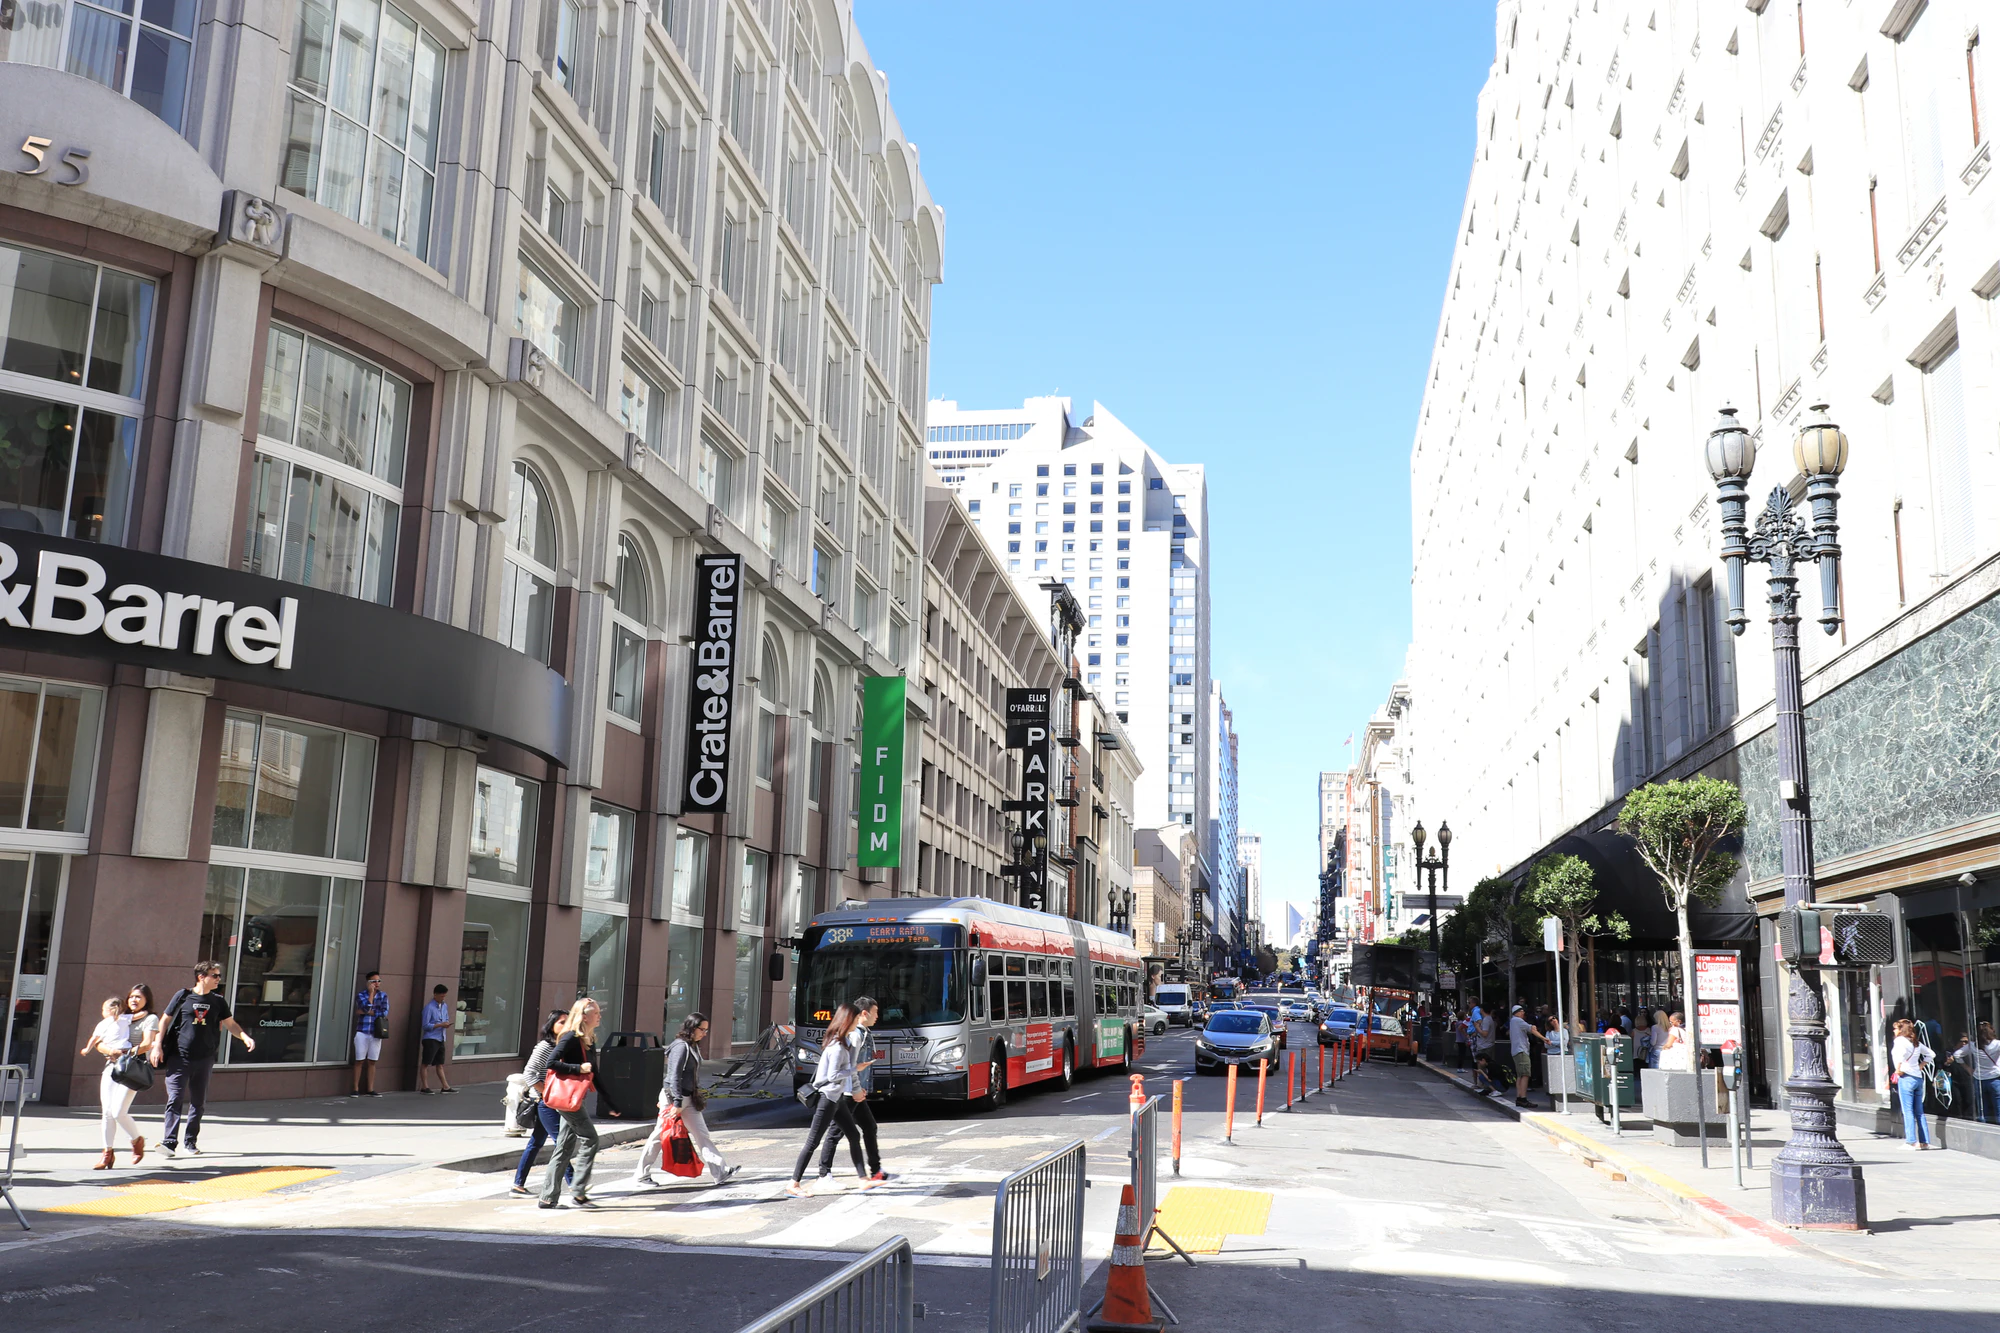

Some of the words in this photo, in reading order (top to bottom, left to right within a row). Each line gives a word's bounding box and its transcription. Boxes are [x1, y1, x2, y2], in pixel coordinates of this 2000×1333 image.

[17, 135, 92, 187] 55
[689, 558, 736, 806] Crate&Barrel
[1028, 694, 1047, 702] ELLIS
[1010, 704, 1046, 712] O'FARRELL
[870, 747, 889, 851] FIDM
[870, 928, 896, 936] GEARY
[899, 926, 925, 935] RAPID
[828, 928, 853, 944] 38R
[907, 935, 930, 943] Term
[1696, 962, 1708, 971] NO
[1698, 1004, 1709, 1015] NO
[1711, 1007, 1737, 1016] PARKING
[813, 1011, 832, 1020] 471
[259, 1019, 294, 1027] Crate&Barrel
